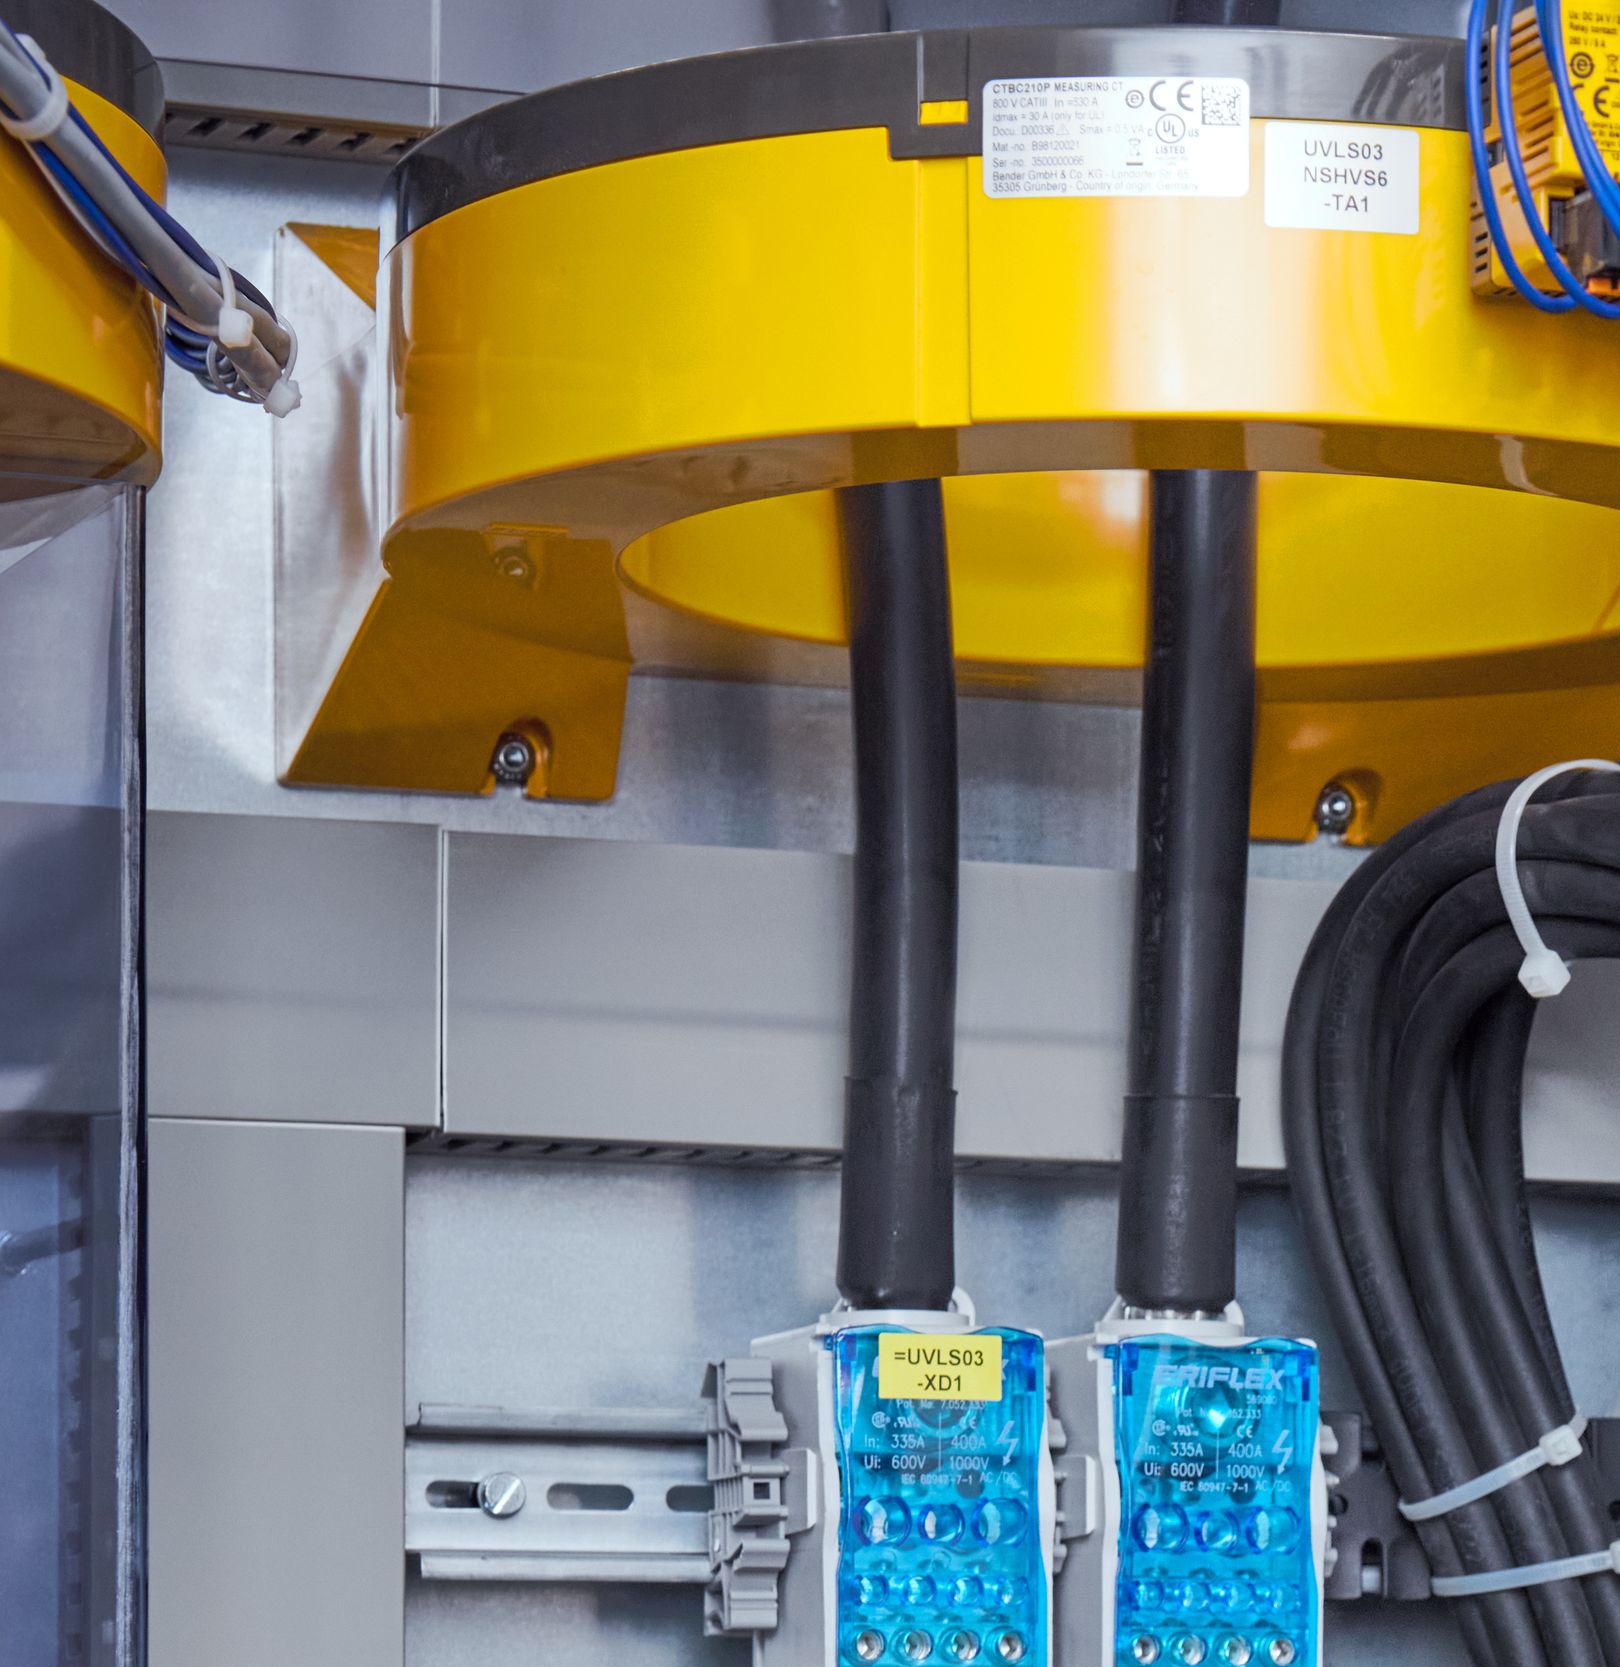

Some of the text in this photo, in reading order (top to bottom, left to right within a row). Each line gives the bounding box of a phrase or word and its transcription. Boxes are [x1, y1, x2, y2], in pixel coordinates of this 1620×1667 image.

[993, 82, 1123, 94] CTBC210P MEASURING CT
[1304, 139, 1383, 160] UVLS03
[993, 171, 1024, 181] Bender
[1304, 166, 1388, 187] NSHVS6
[993, 182, 1020, 192] 35305
[1325, 194, 1368, 212] -TA1
[894, 1348, 984, 1366] =UVLS03
[918, 1375, 962, 1391] -XD1
[1155, 1365, 1285, 1390] ERIFLEX
[891, 1435, 925, 1448] 335A
[951, 1435, 985, 1449] 400A
[1171, 1442, 1203, 1456] 335A
[1228, 1444, 1262, 1457] 400A
[891, 1456, 926, 1469] 600V
[950, 1457, 989, 1470] 1000V
[1171, 1463, 1204, 1477] 600V
[1227, 1465, 1264, 1478] 1000V
